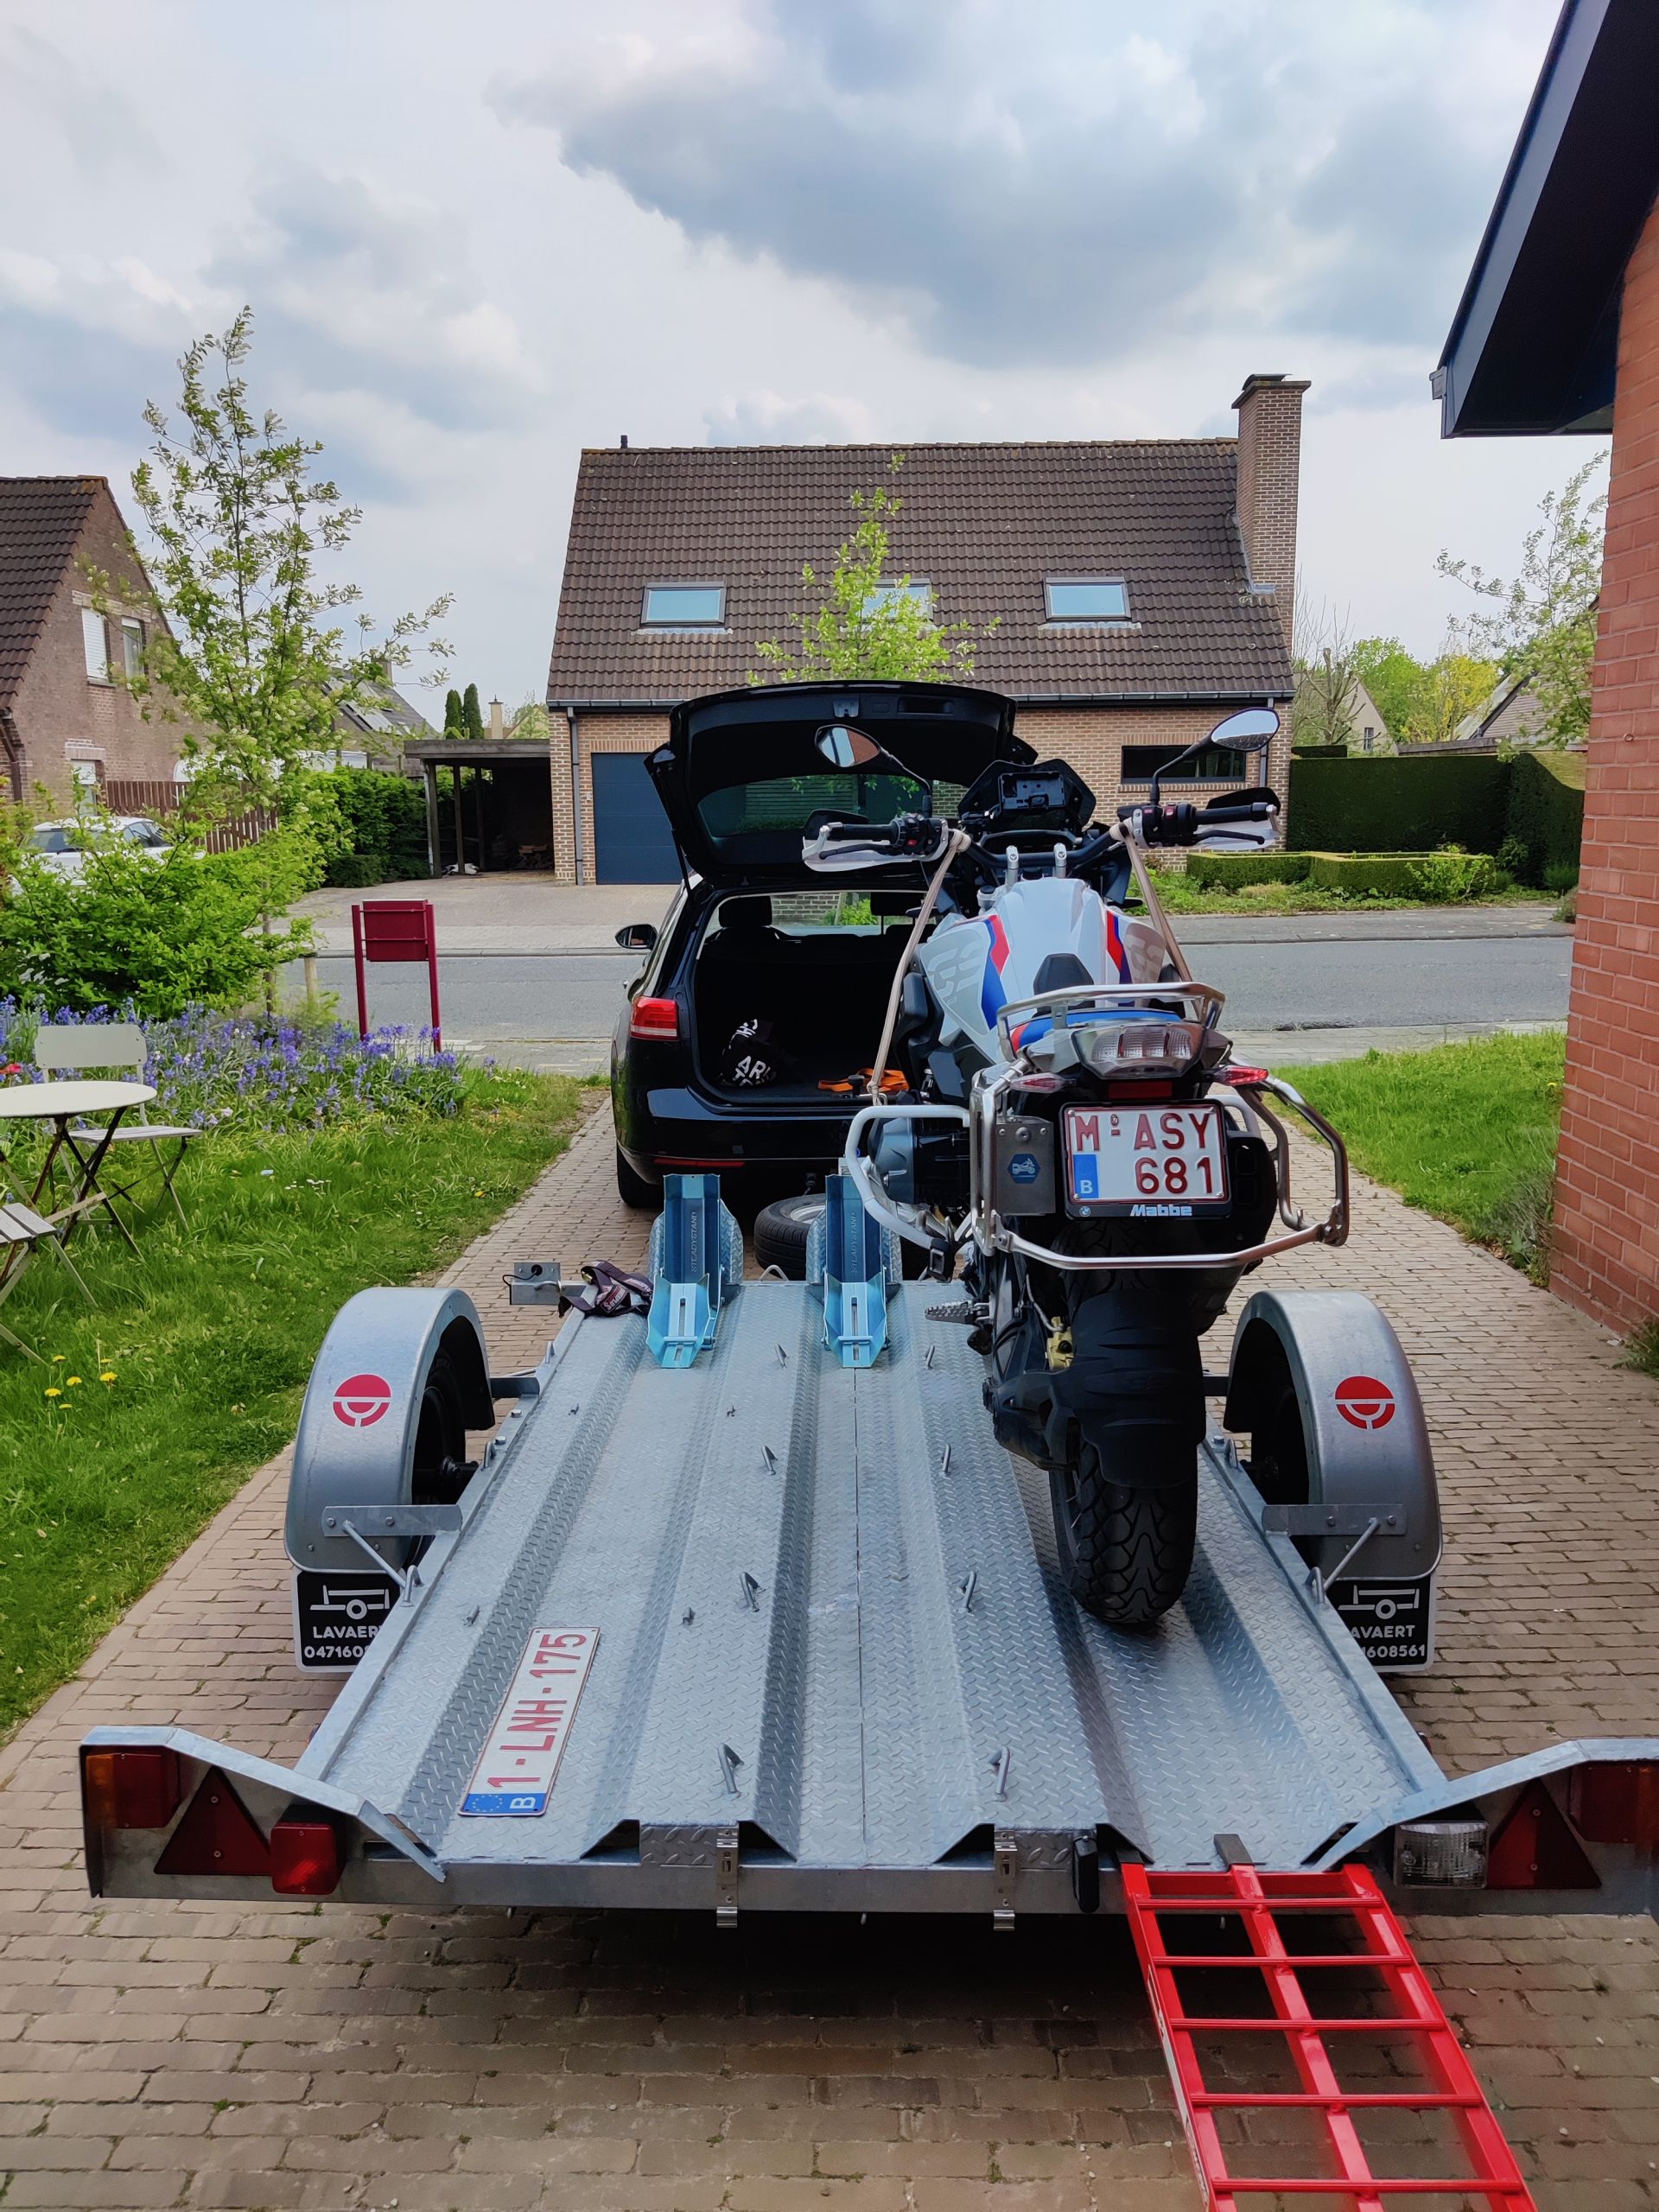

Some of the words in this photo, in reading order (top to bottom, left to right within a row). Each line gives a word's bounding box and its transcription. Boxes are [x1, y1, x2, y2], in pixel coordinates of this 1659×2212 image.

[1135, 1156, 1212, 1194] 681
[1080, 1179, 1093, 1194] B
[1130, 1204, 1192, 1217] Mabbe
[313, 1625, 383, 1638] LAVAER
[1351, 1624, 1415, 1638] AVAERT
[304, 1645, 370, 1658] 047160
[487, 1633, 587, 1788] 1-LNH-175
[509, 1796, 536, 1809] B
